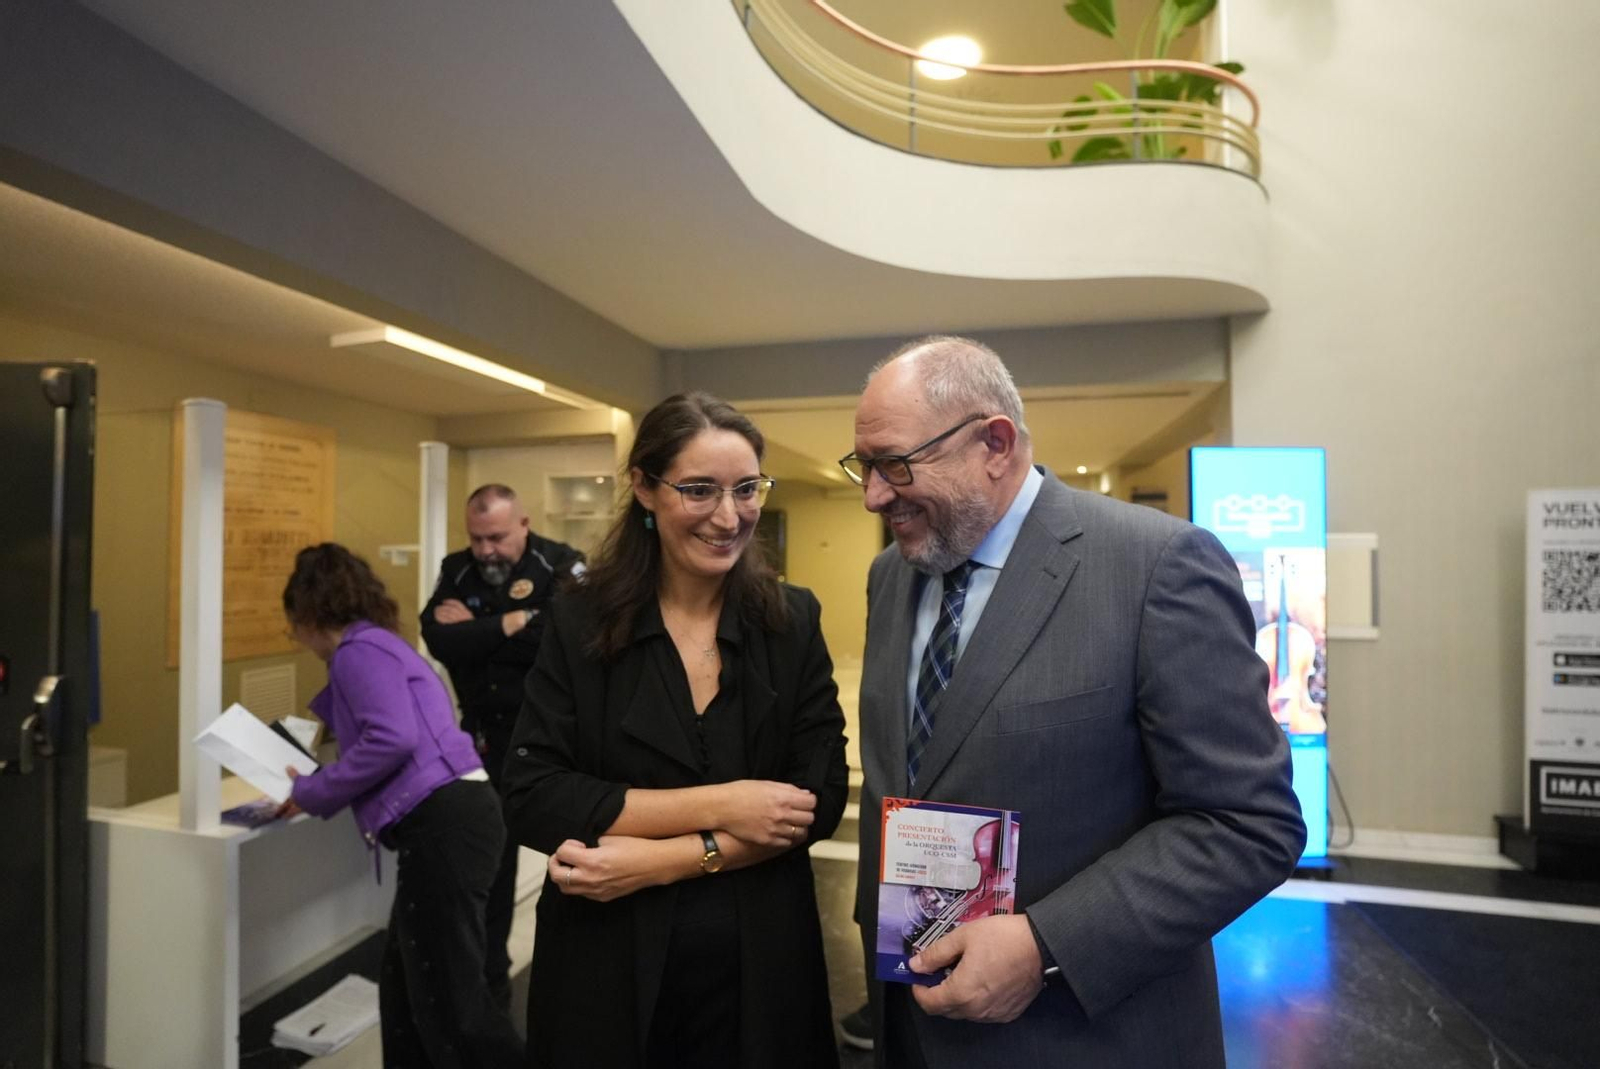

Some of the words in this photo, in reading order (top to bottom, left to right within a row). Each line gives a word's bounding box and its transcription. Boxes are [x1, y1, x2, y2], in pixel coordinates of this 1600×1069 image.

[897, 824, 945, 834] CONCIERTO
[897, 832, 956, 843] PRESENTACIÓN
[919, 842, 957, 852] ORQUESTA
